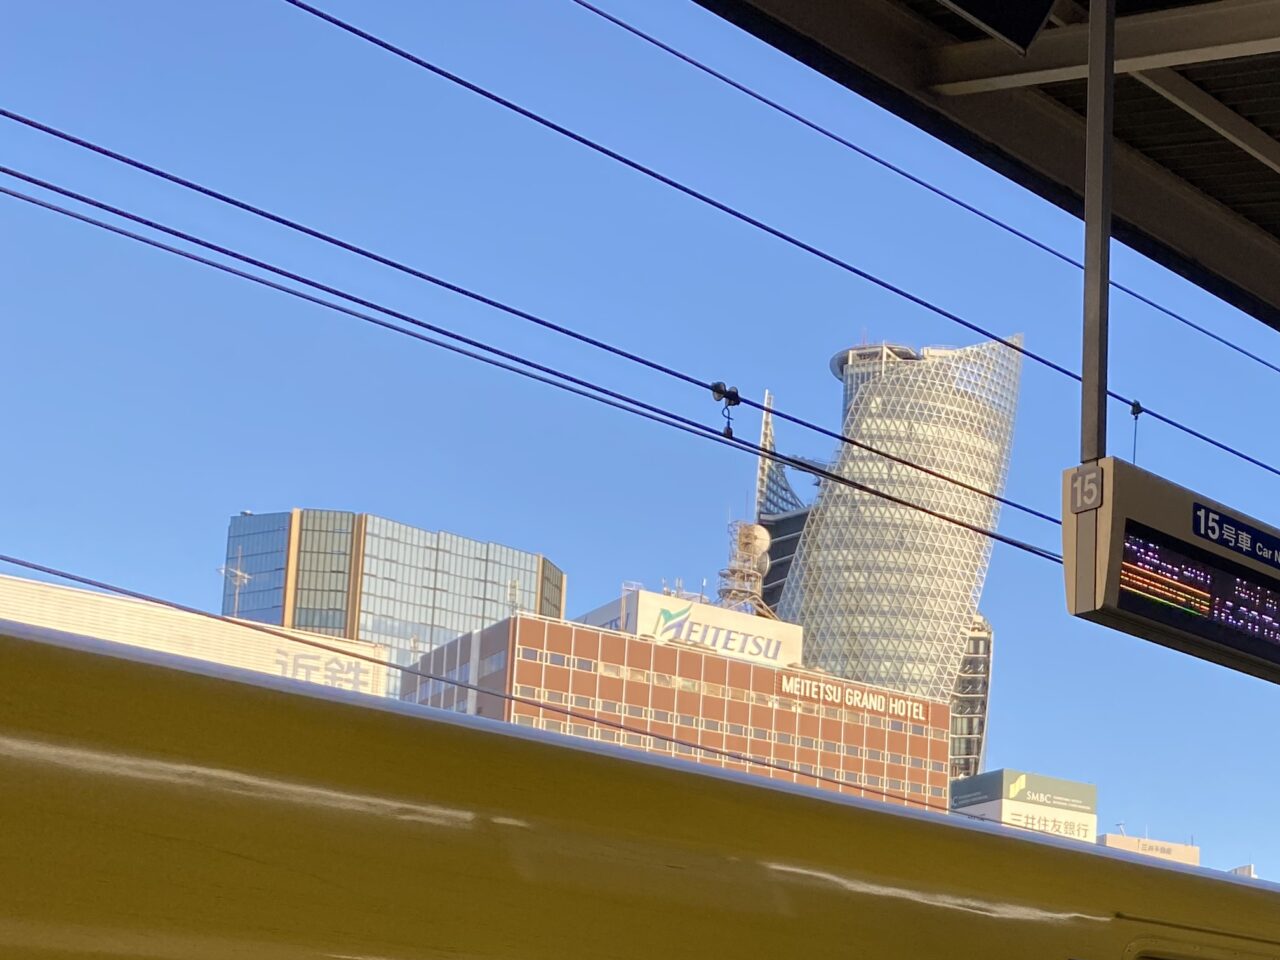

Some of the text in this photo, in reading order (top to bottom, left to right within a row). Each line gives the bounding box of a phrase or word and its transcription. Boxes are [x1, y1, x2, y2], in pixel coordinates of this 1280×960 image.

[1073, 472, 1097, 507] 15
[1256, 543, 1272, 560] Car
[653, 603, 783, 660] MEITETSU
[781, 675, 926, 720] MEITETSU GRAND HOTEL
[1026, 791, 1052, 804] SMBC
[1010, 812, 1089, 838] 三井住友銀行
